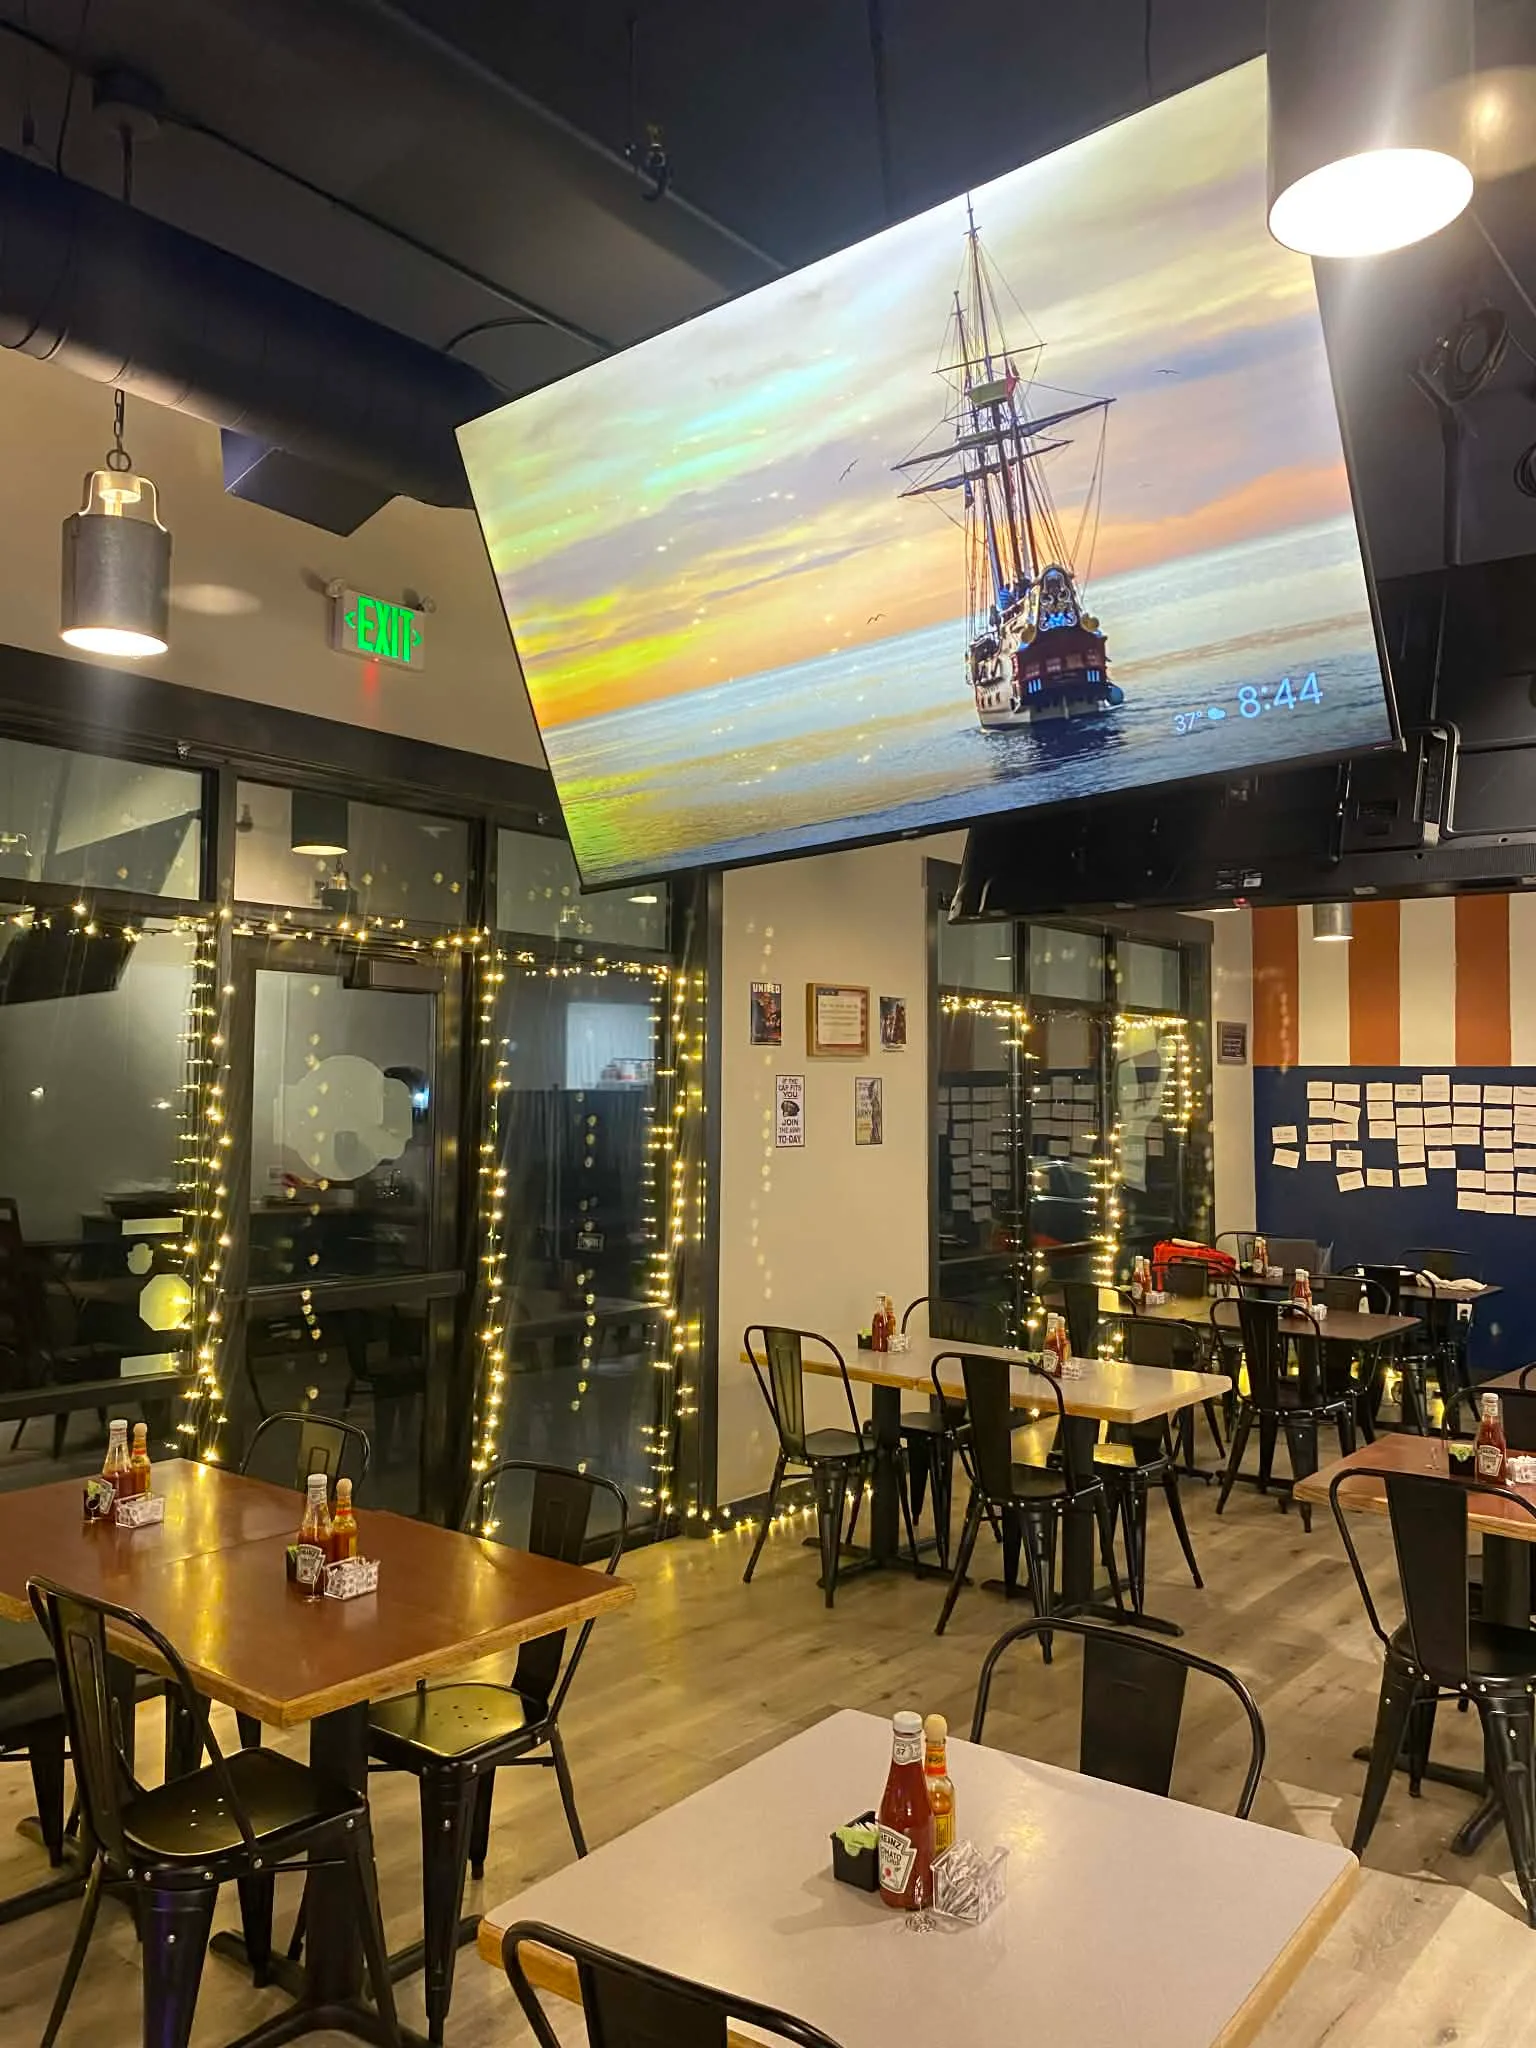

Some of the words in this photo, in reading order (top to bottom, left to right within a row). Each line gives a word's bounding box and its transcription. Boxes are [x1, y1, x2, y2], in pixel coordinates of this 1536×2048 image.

[358, 596, 414, 661] EXIT
[1238, 672, 1323, 718] 8:44
[752, 983, 781, 994] UNITED
